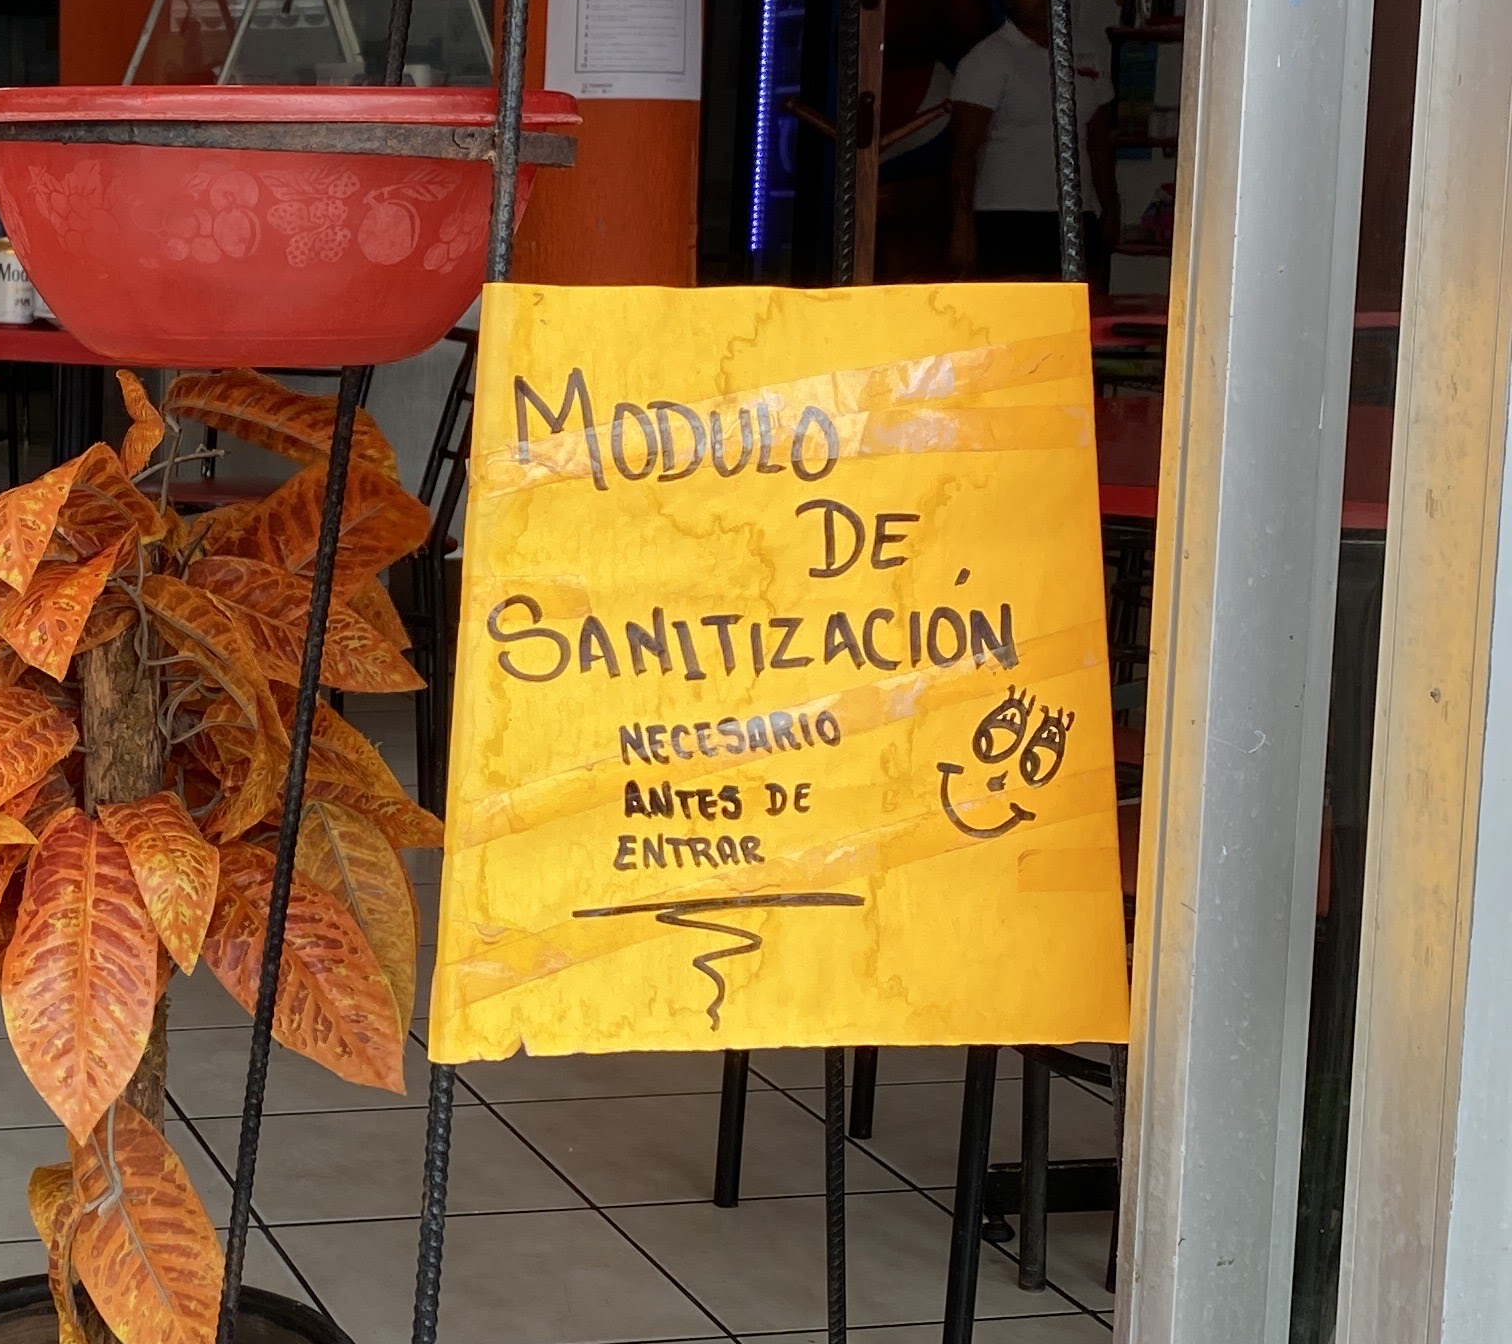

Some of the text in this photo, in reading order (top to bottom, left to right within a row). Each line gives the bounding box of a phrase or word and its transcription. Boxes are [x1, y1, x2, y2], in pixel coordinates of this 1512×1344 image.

[512, 367, 841, 491] MODULO
[795, 498, 920, 579] DE
[486, 567, 1020, 683] SANITIZACIÓN
[620, 711, 842, 765] NECESARIO
[622, 779, 812, 820] ANTES DE
[612, 834, 767, 873] ENTRAR
